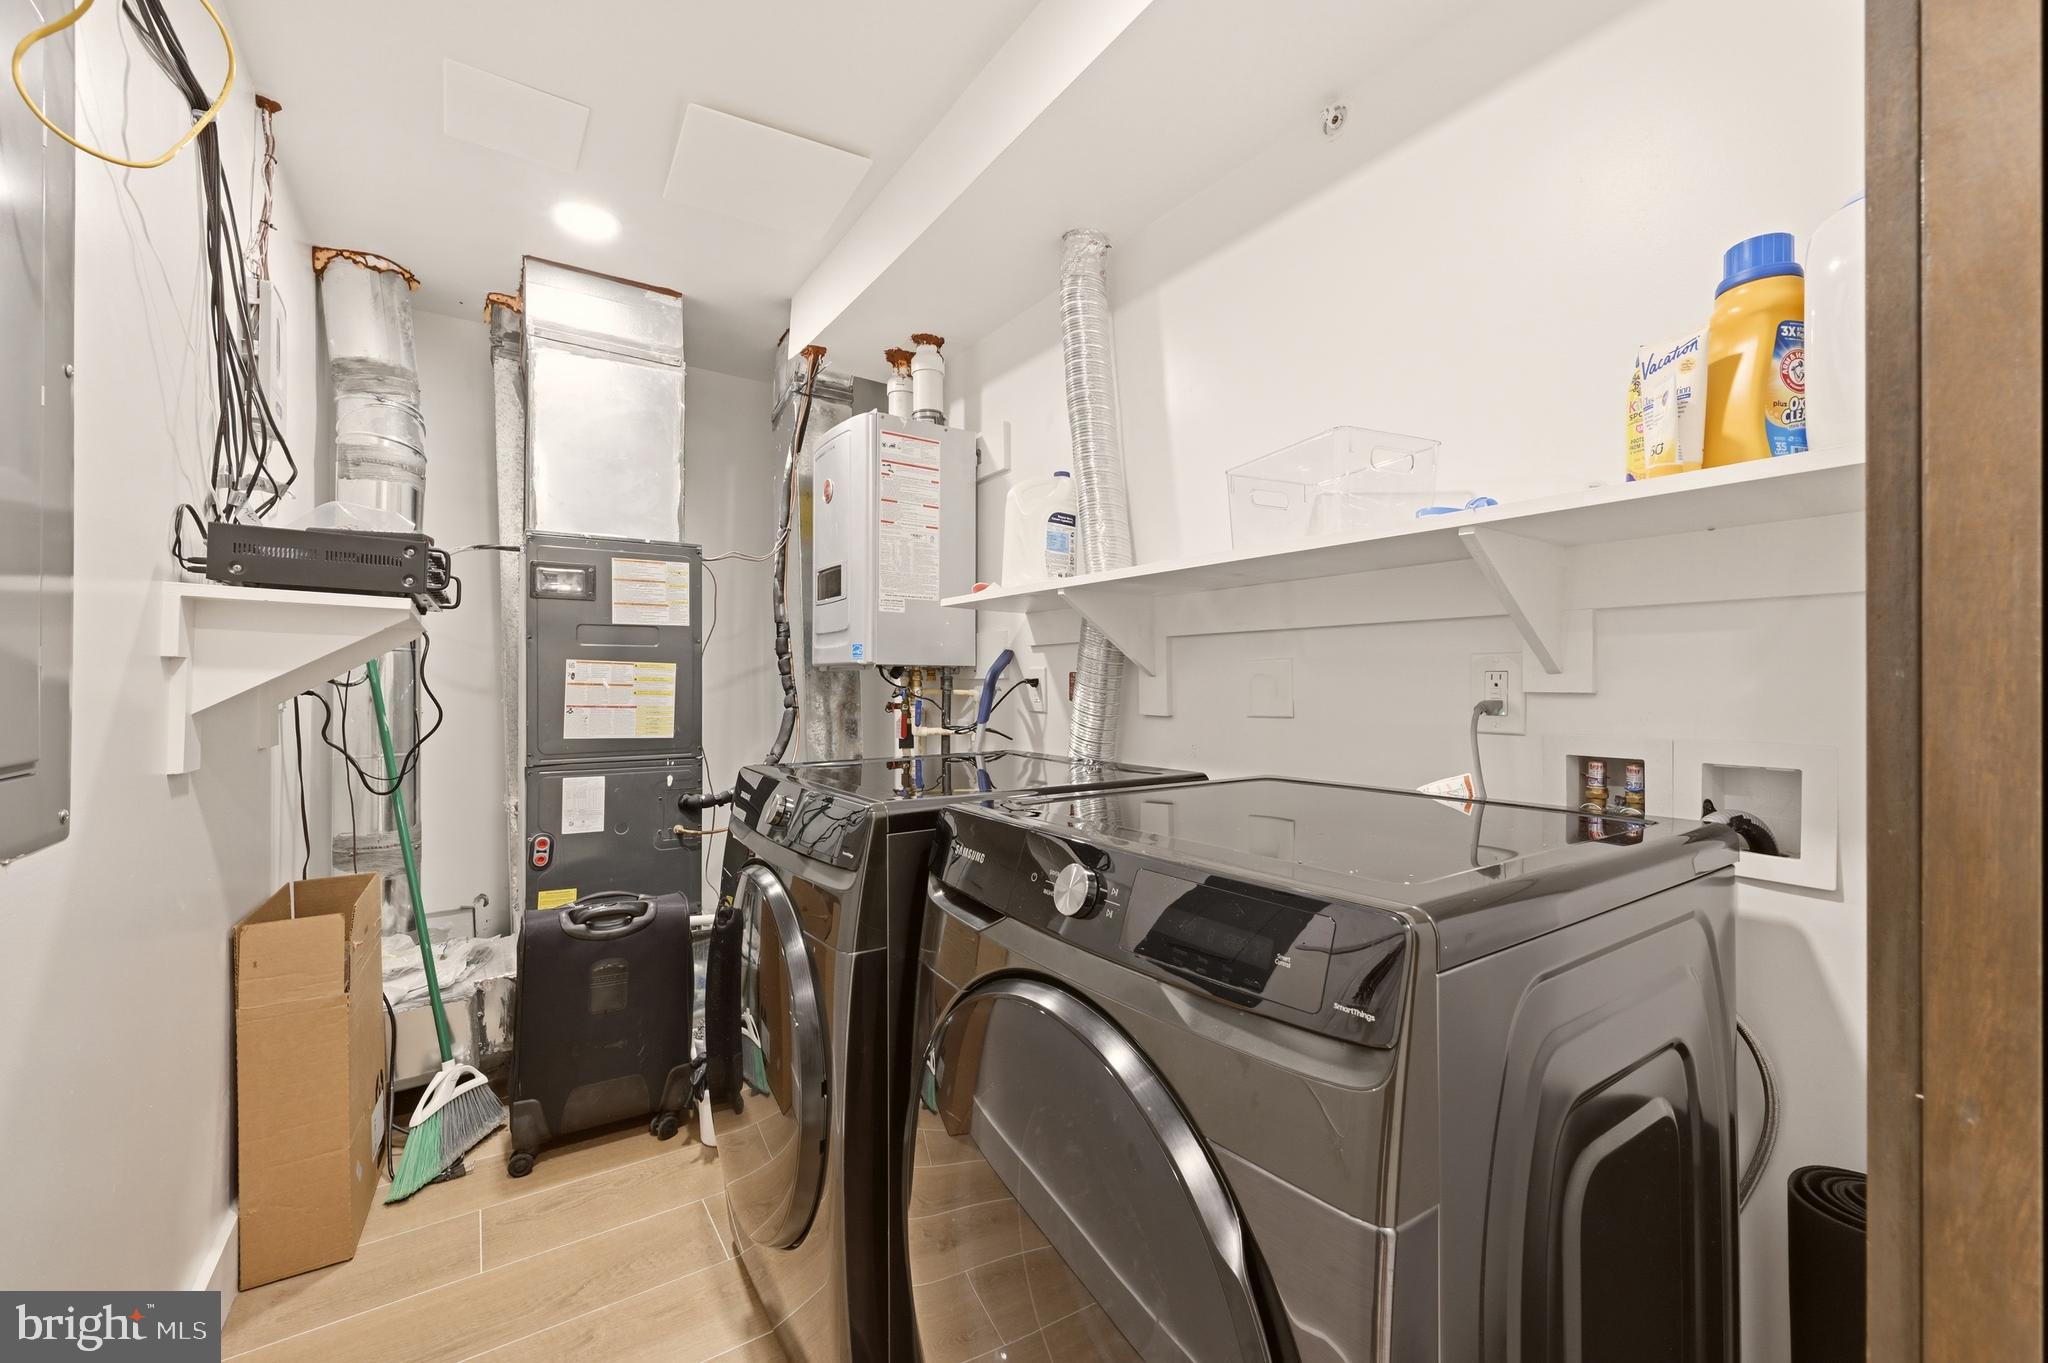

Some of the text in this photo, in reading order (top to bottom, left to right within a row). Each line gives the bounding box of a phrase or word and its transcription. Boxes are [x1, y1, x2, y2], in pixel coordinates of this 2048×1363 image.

[1780, 325, 1797, 337] 3X
[1641, 336, 1699, 380] Vacation
[1772, 400, 1788, 408] plus
[954, 844, 986, 864] SAMSUNG
[1333, 1002, 1376, 1022] SmartThings
